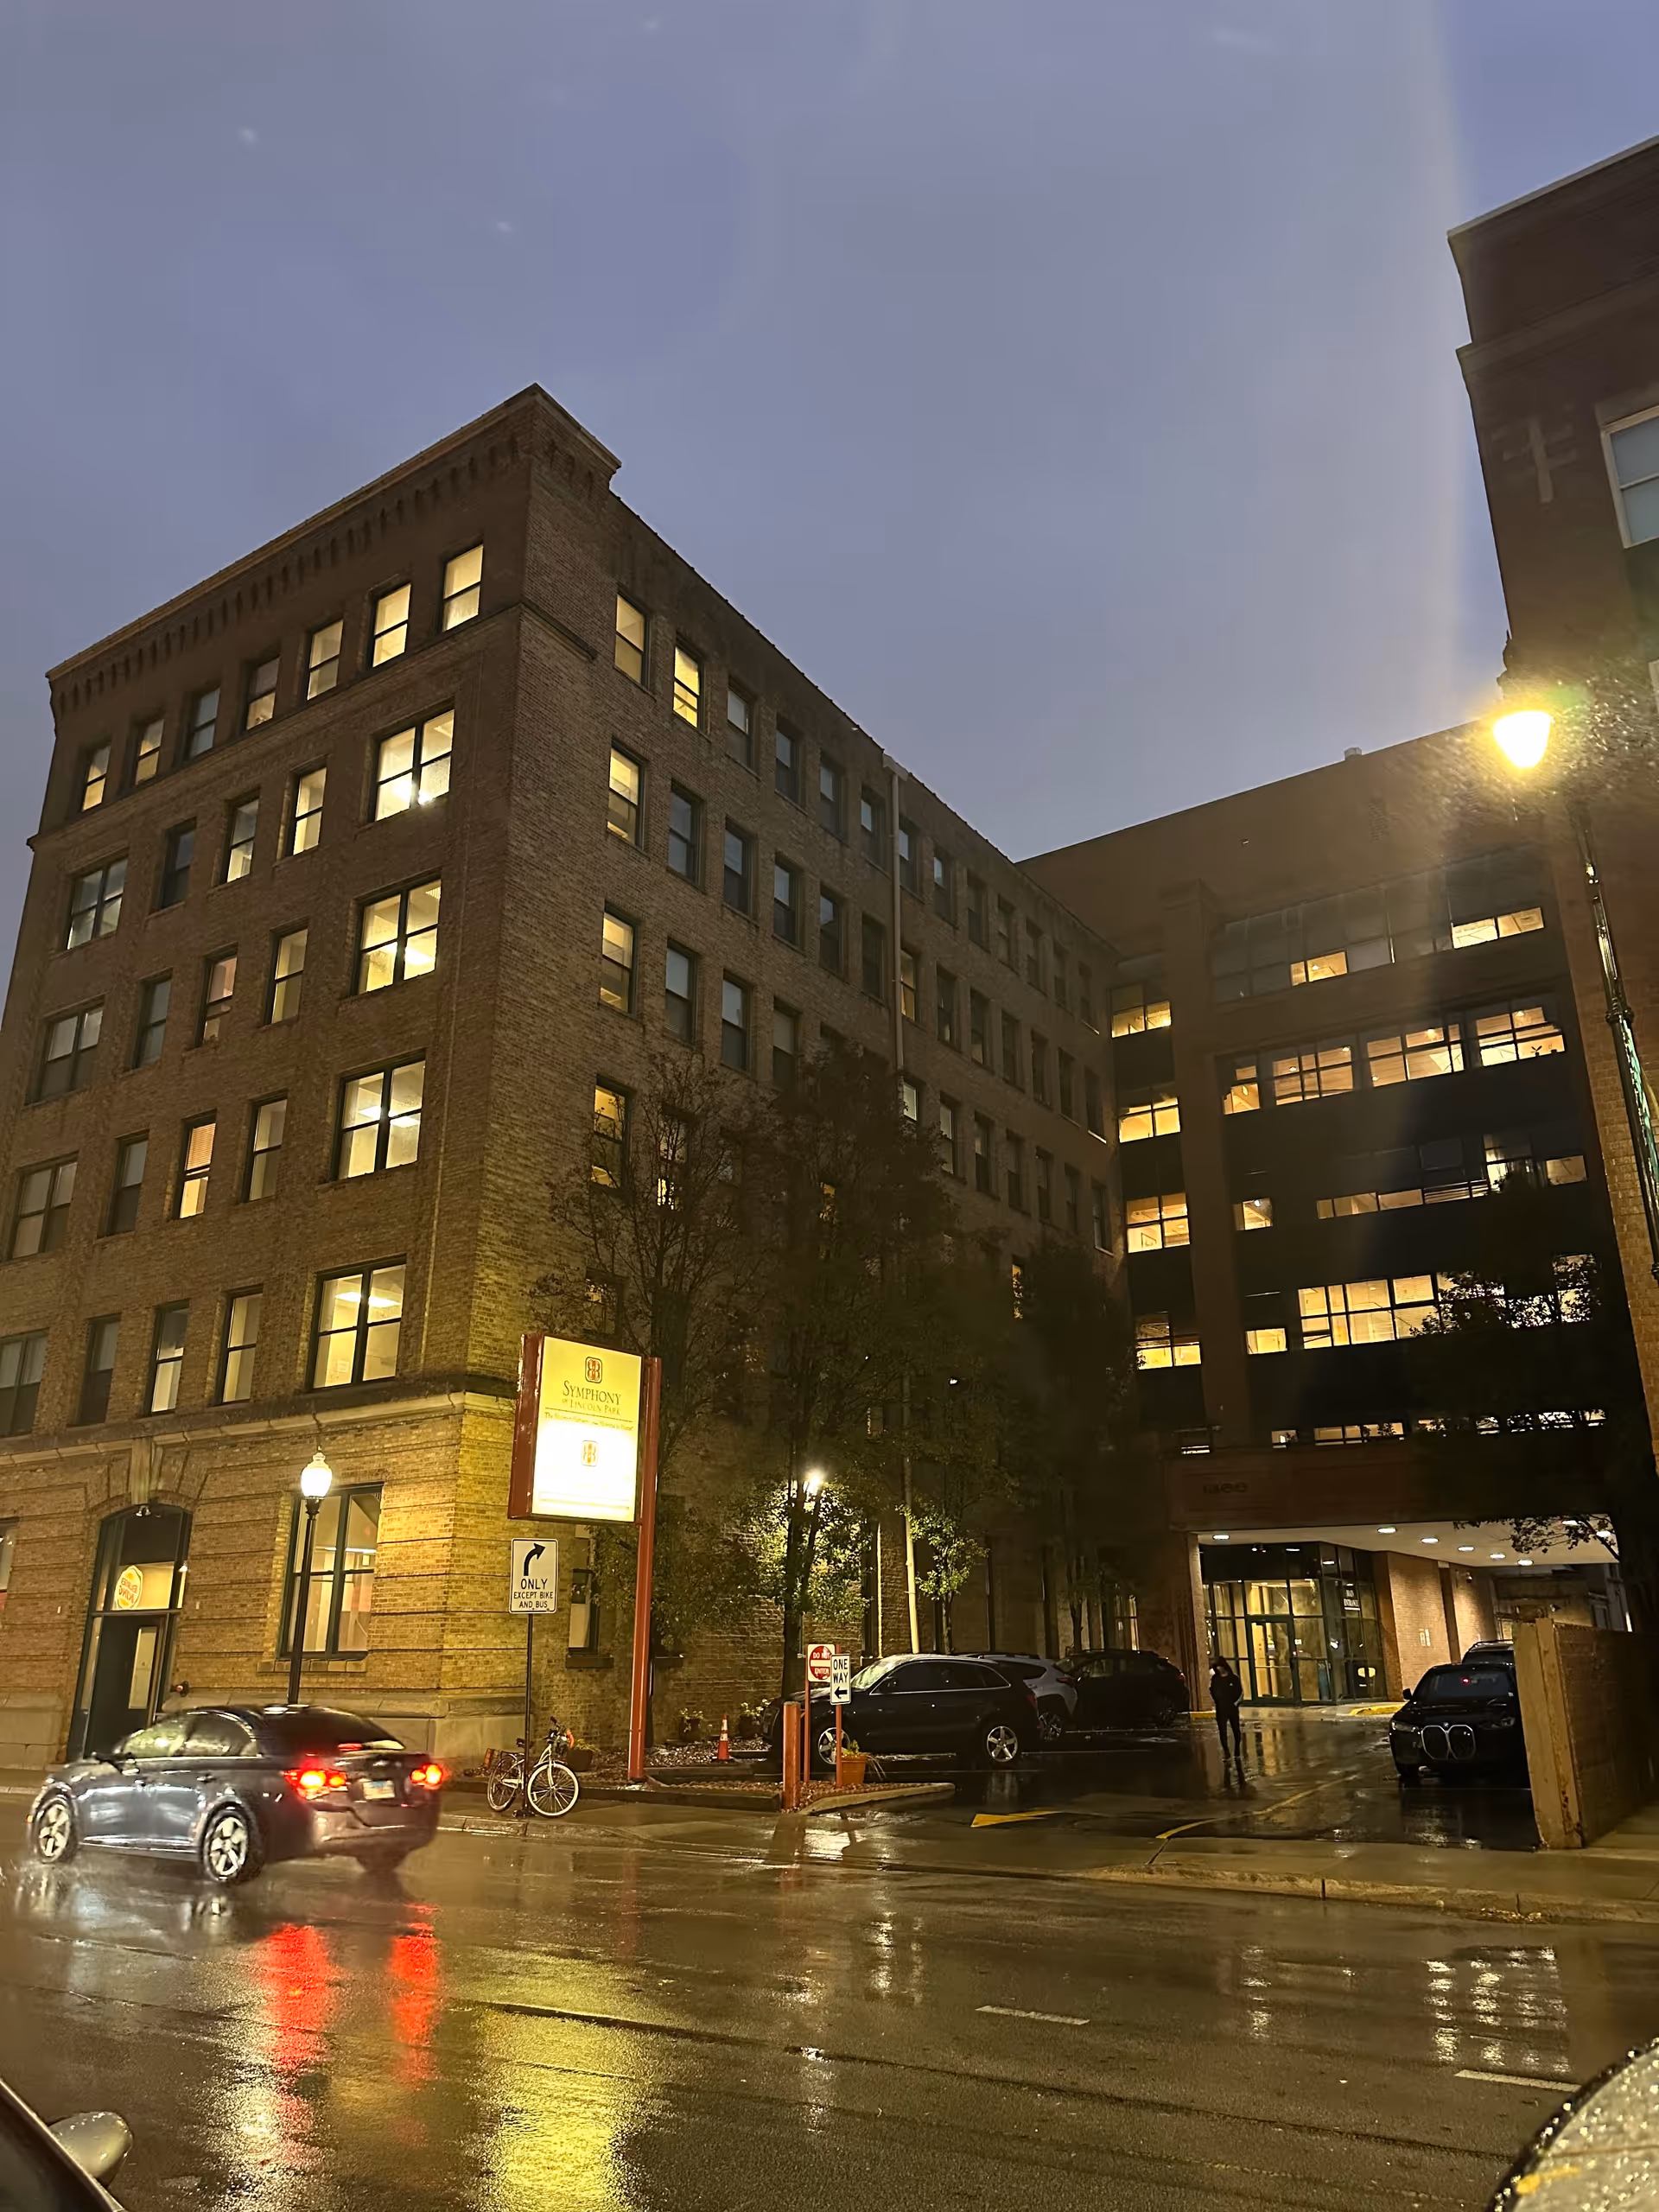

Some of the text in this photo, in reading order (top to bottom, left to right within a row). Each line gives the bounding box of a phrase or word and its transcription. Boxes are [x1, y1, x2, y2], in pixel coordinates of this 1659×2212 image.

[563, 1380, 621, 1405] SYMPHONY
[570, 1399, 601, 1413] LINCOLN
[604, 1404, 620, 1416] PARK
[520, 1578, 548, 1590] ONLY
[513, 1591, 537, 1599] EXCEPT
[833, 1658, 849, 1670] ONE
[832, 1672, 848, 1683] WAY
